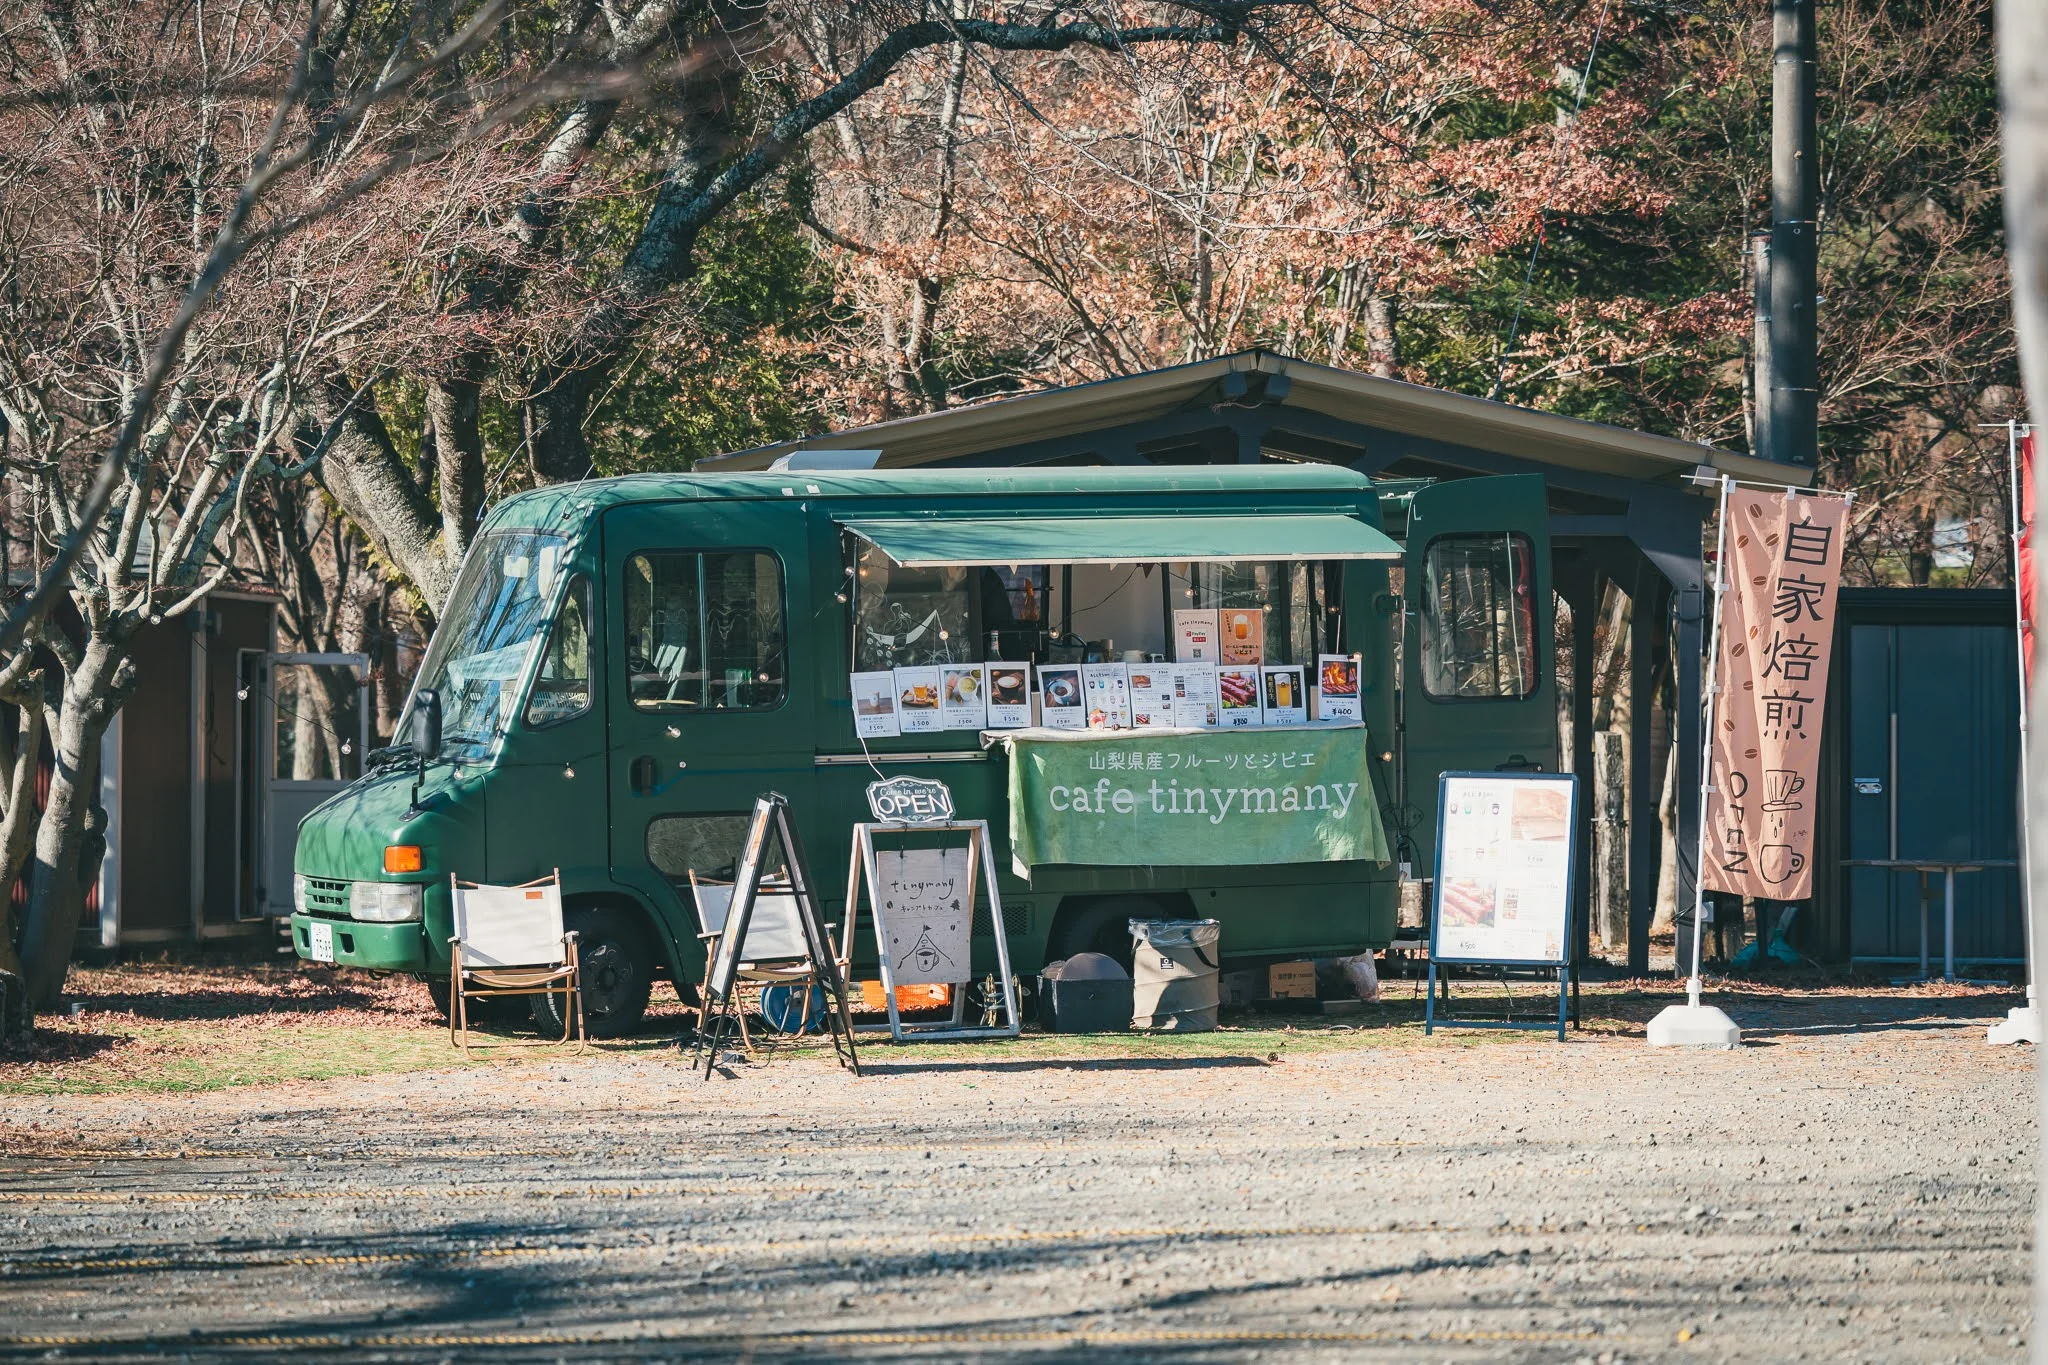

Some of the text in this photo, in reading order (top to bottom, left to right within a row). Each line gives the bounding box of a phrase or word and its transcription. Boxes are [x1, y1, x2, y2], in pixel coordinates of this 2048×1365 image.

[1761, 516, 1832, 740] 自家焙煎
[1089, 751, 1317, 771] 山梨県産フルーツとジビエ
[880, 787, 902, 797] Come
[914, 786, 936, 795] we're
[1049, 778, 1358, 825] cafe tinymany
[877, 793, 949, 815] OPEN
[1722, 771, 1749, 874] OPEN
[890, 877, 954, 900] tinymany
[1460, 941, 1476, 950] ¥500
